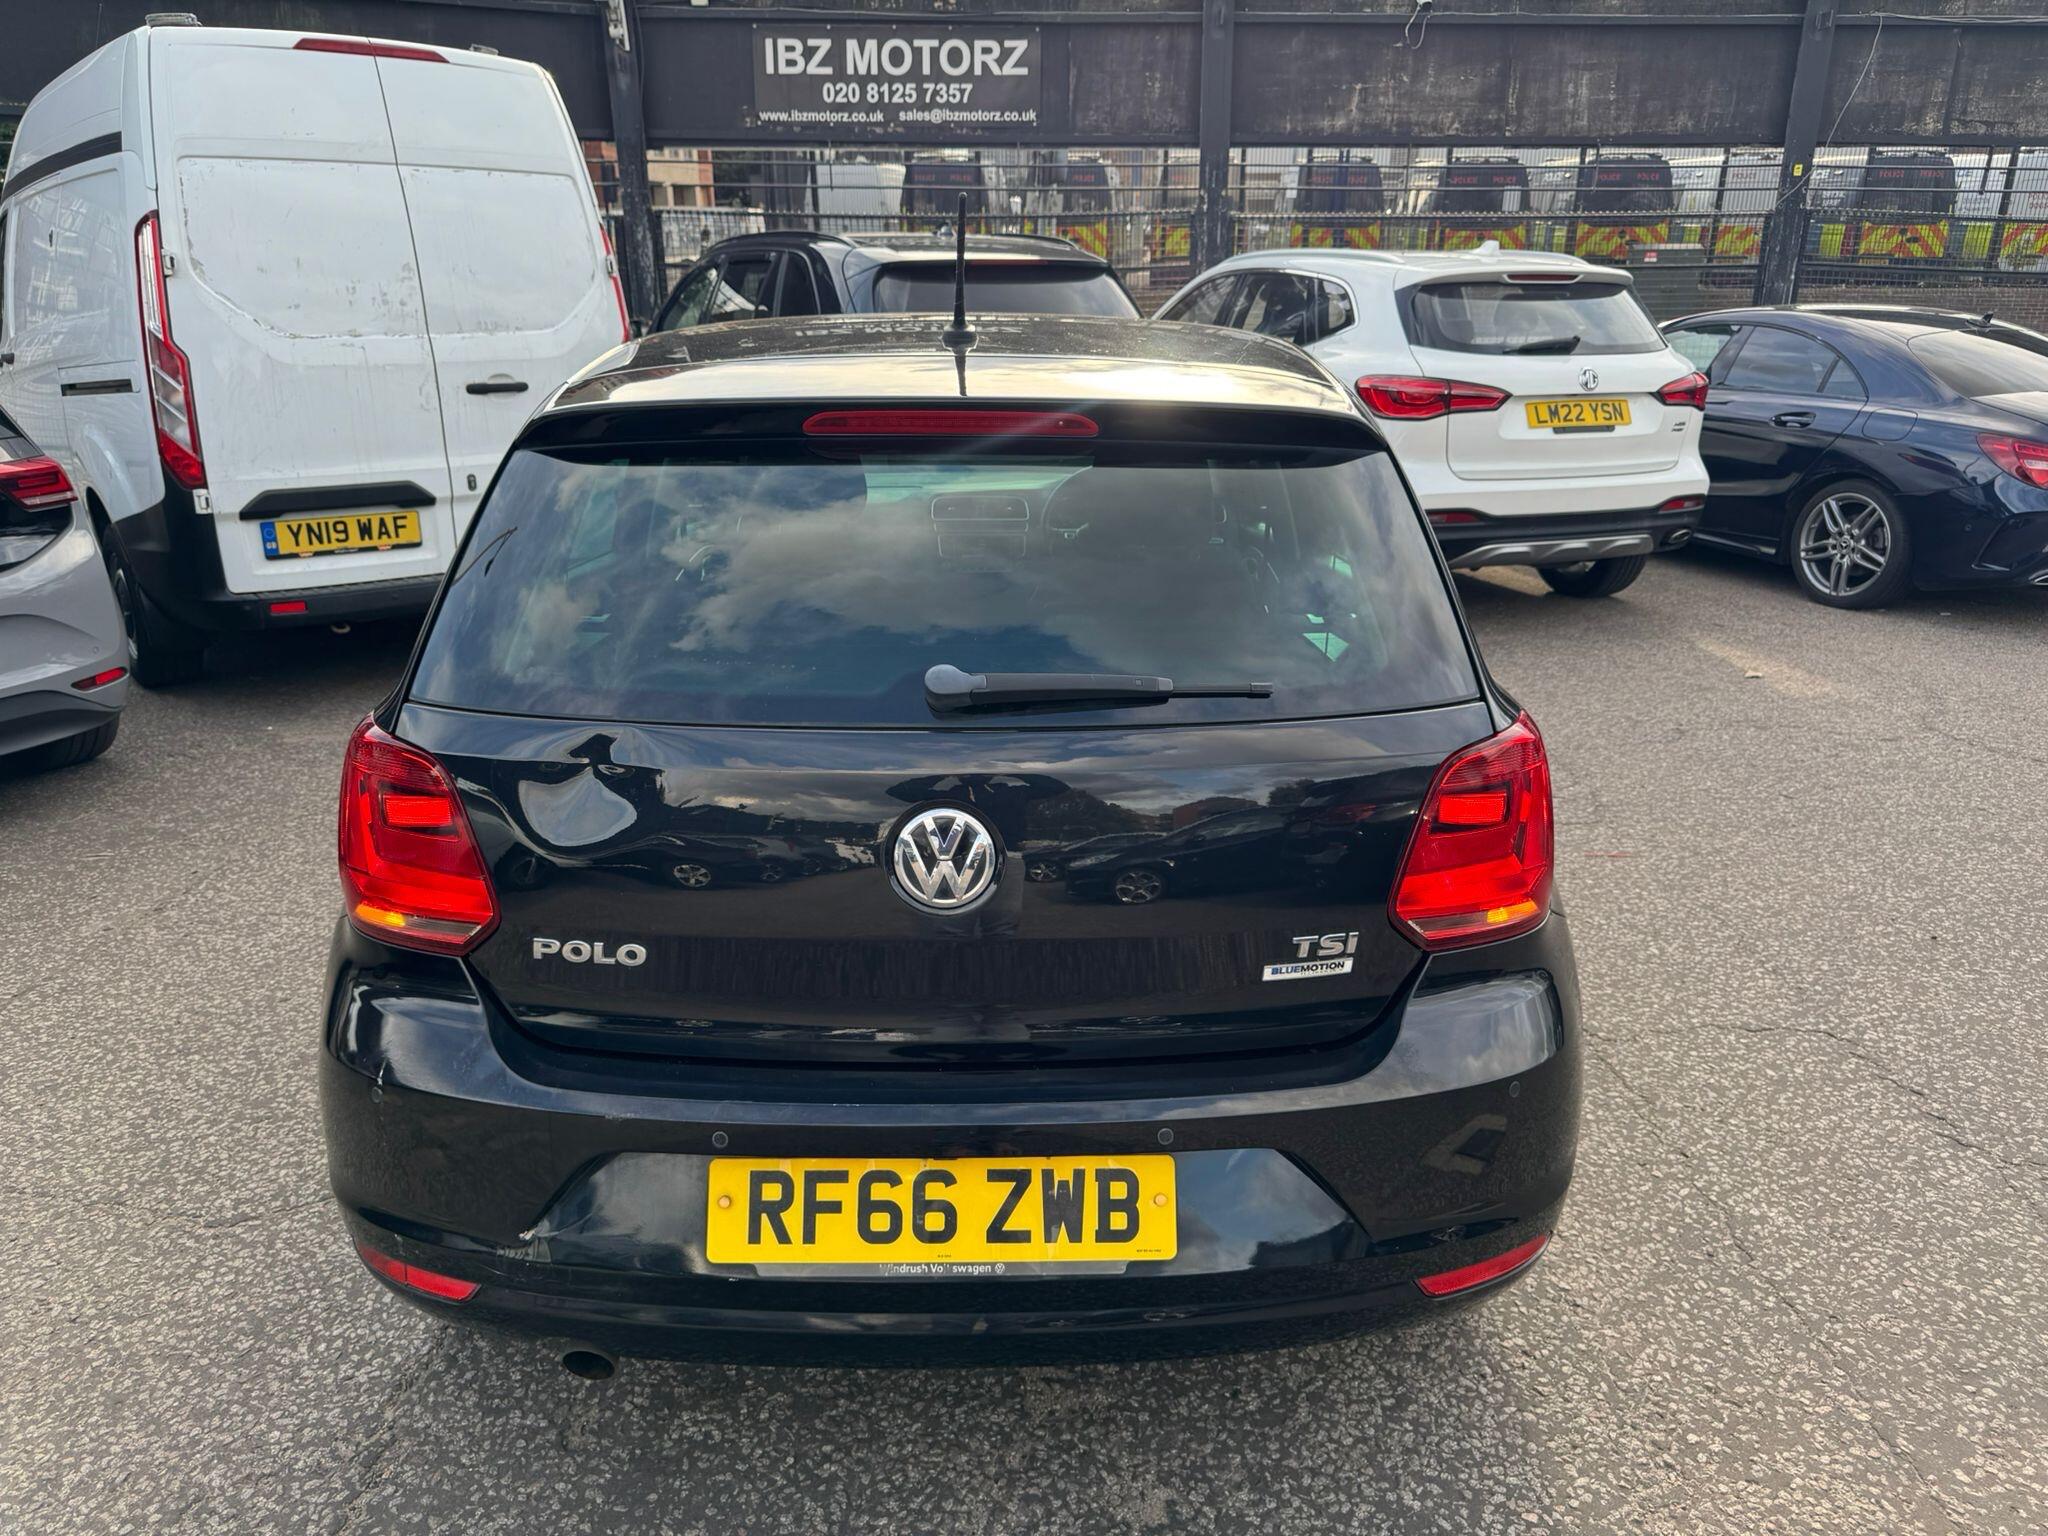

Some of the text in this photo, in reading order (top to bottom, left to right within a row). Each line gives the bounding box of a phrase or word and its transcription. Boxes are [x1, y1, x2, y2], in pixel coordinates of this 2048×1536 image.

[765, 38, 1029, 76] IBZ MOTORZ
[822, 82, 973, 104] 020 8125 7357
[759, 107, 1037, 123] www.ibzmotorz.co.uk sales@ibzmotorz.co.uk
[1579, 368, 1599, 391] MG
[1534, 402, 1624, 424] LM22 YSN
[287, 515, 408, 547] YN19 WAF
[533, 938, 647, 967] POLO
[1292, 932, 1359, 958] TSI
[1271, 961, 1345, 975] BLUEMOTION
[747, 1168, 1140, 1245] RF66 ZWB
[879, 1263, 928, 1274] ndrush
[930, 1263, 992, 1275] Voswagen
